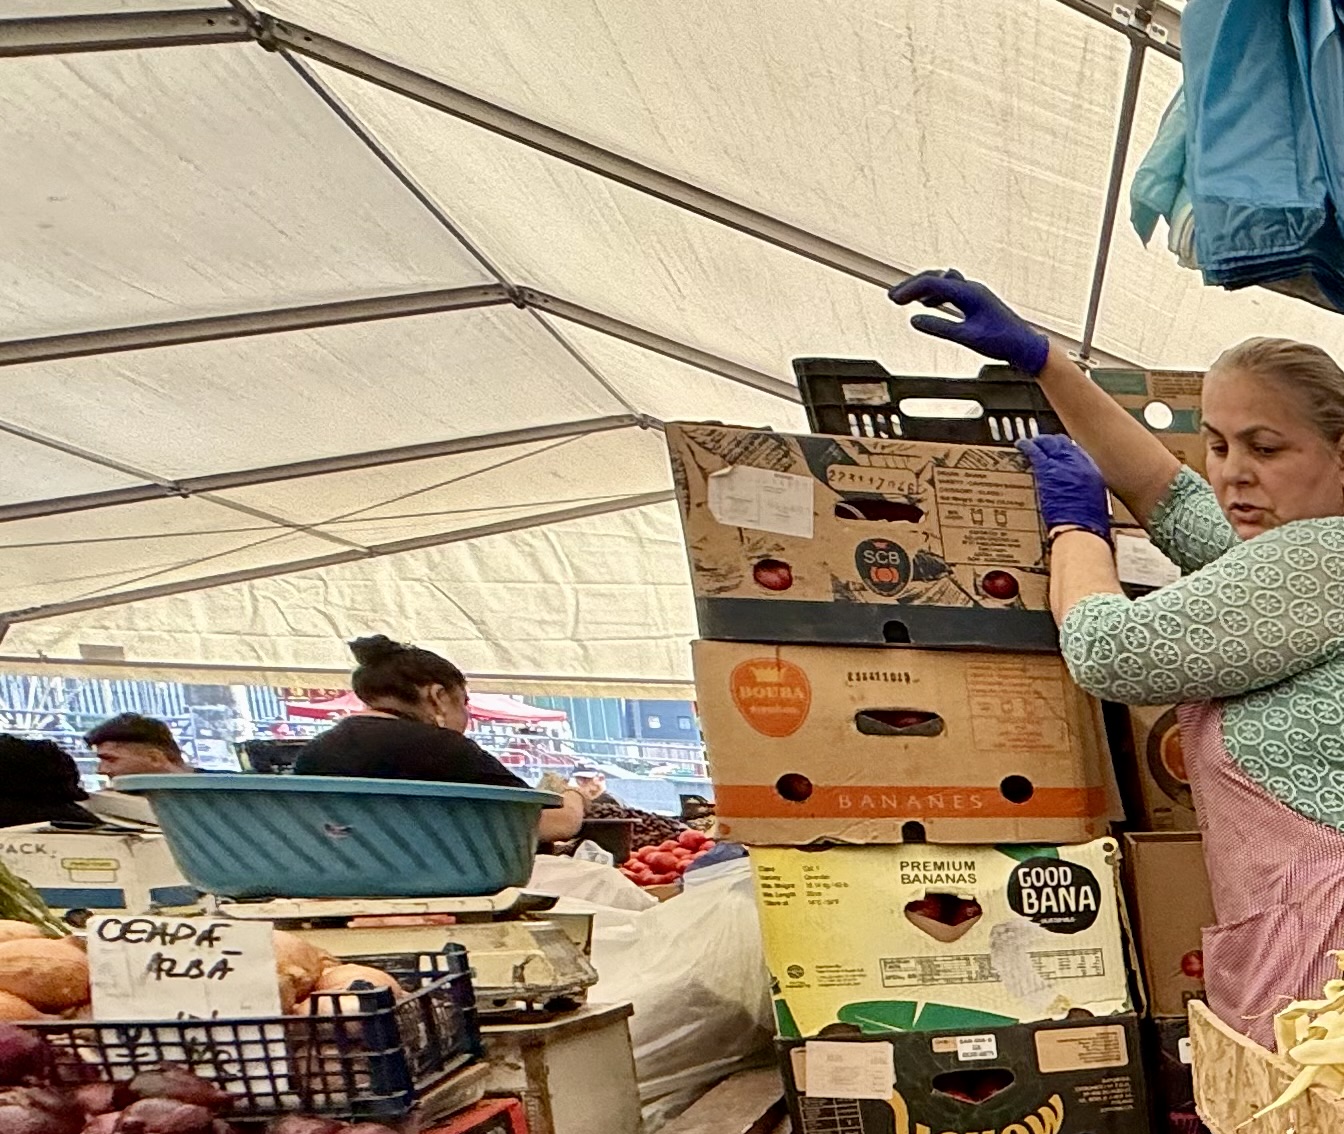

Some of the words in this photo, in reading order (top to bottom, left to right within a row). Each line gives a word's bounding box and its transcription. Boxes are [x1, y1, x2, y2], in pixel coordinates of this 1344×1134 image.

[863, 550, 900, 565] SCB
[839, 794, 984, 810] BANANES
[900, 861, 976, 872] PREMIUM
[901, 873, 978, 885] BANANAS
[1018, 866, 1072, 888] GOOD
[1022, 888, 1097, 915] BANA
